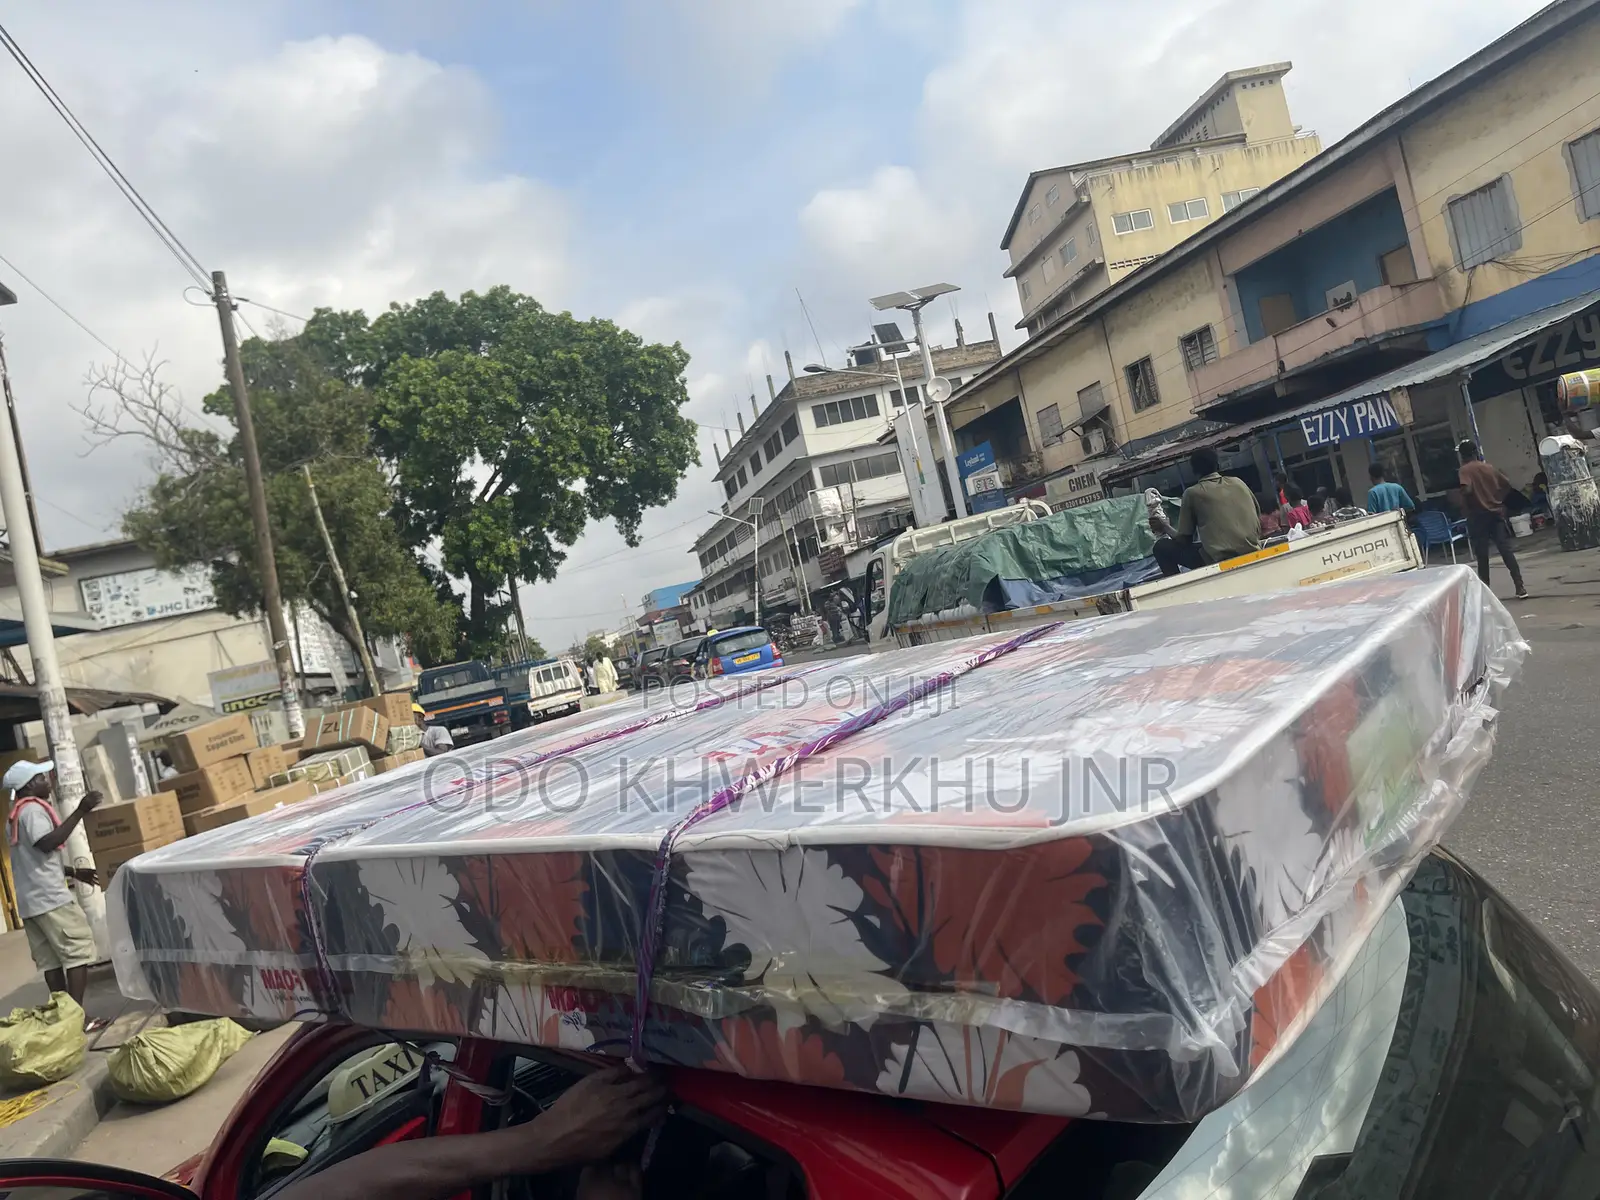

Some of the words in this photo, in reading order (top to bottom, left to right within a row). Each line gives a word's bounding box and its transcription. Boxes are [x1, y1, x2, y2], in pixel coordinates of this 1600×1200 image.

[1301, 407, 1350, 446] EZZY
[1068, 471, 1096, 492] CHEM
[1321, 538, 1389, 565] HYUNDAI
[351, 1046, 418, 1099] TAXI
